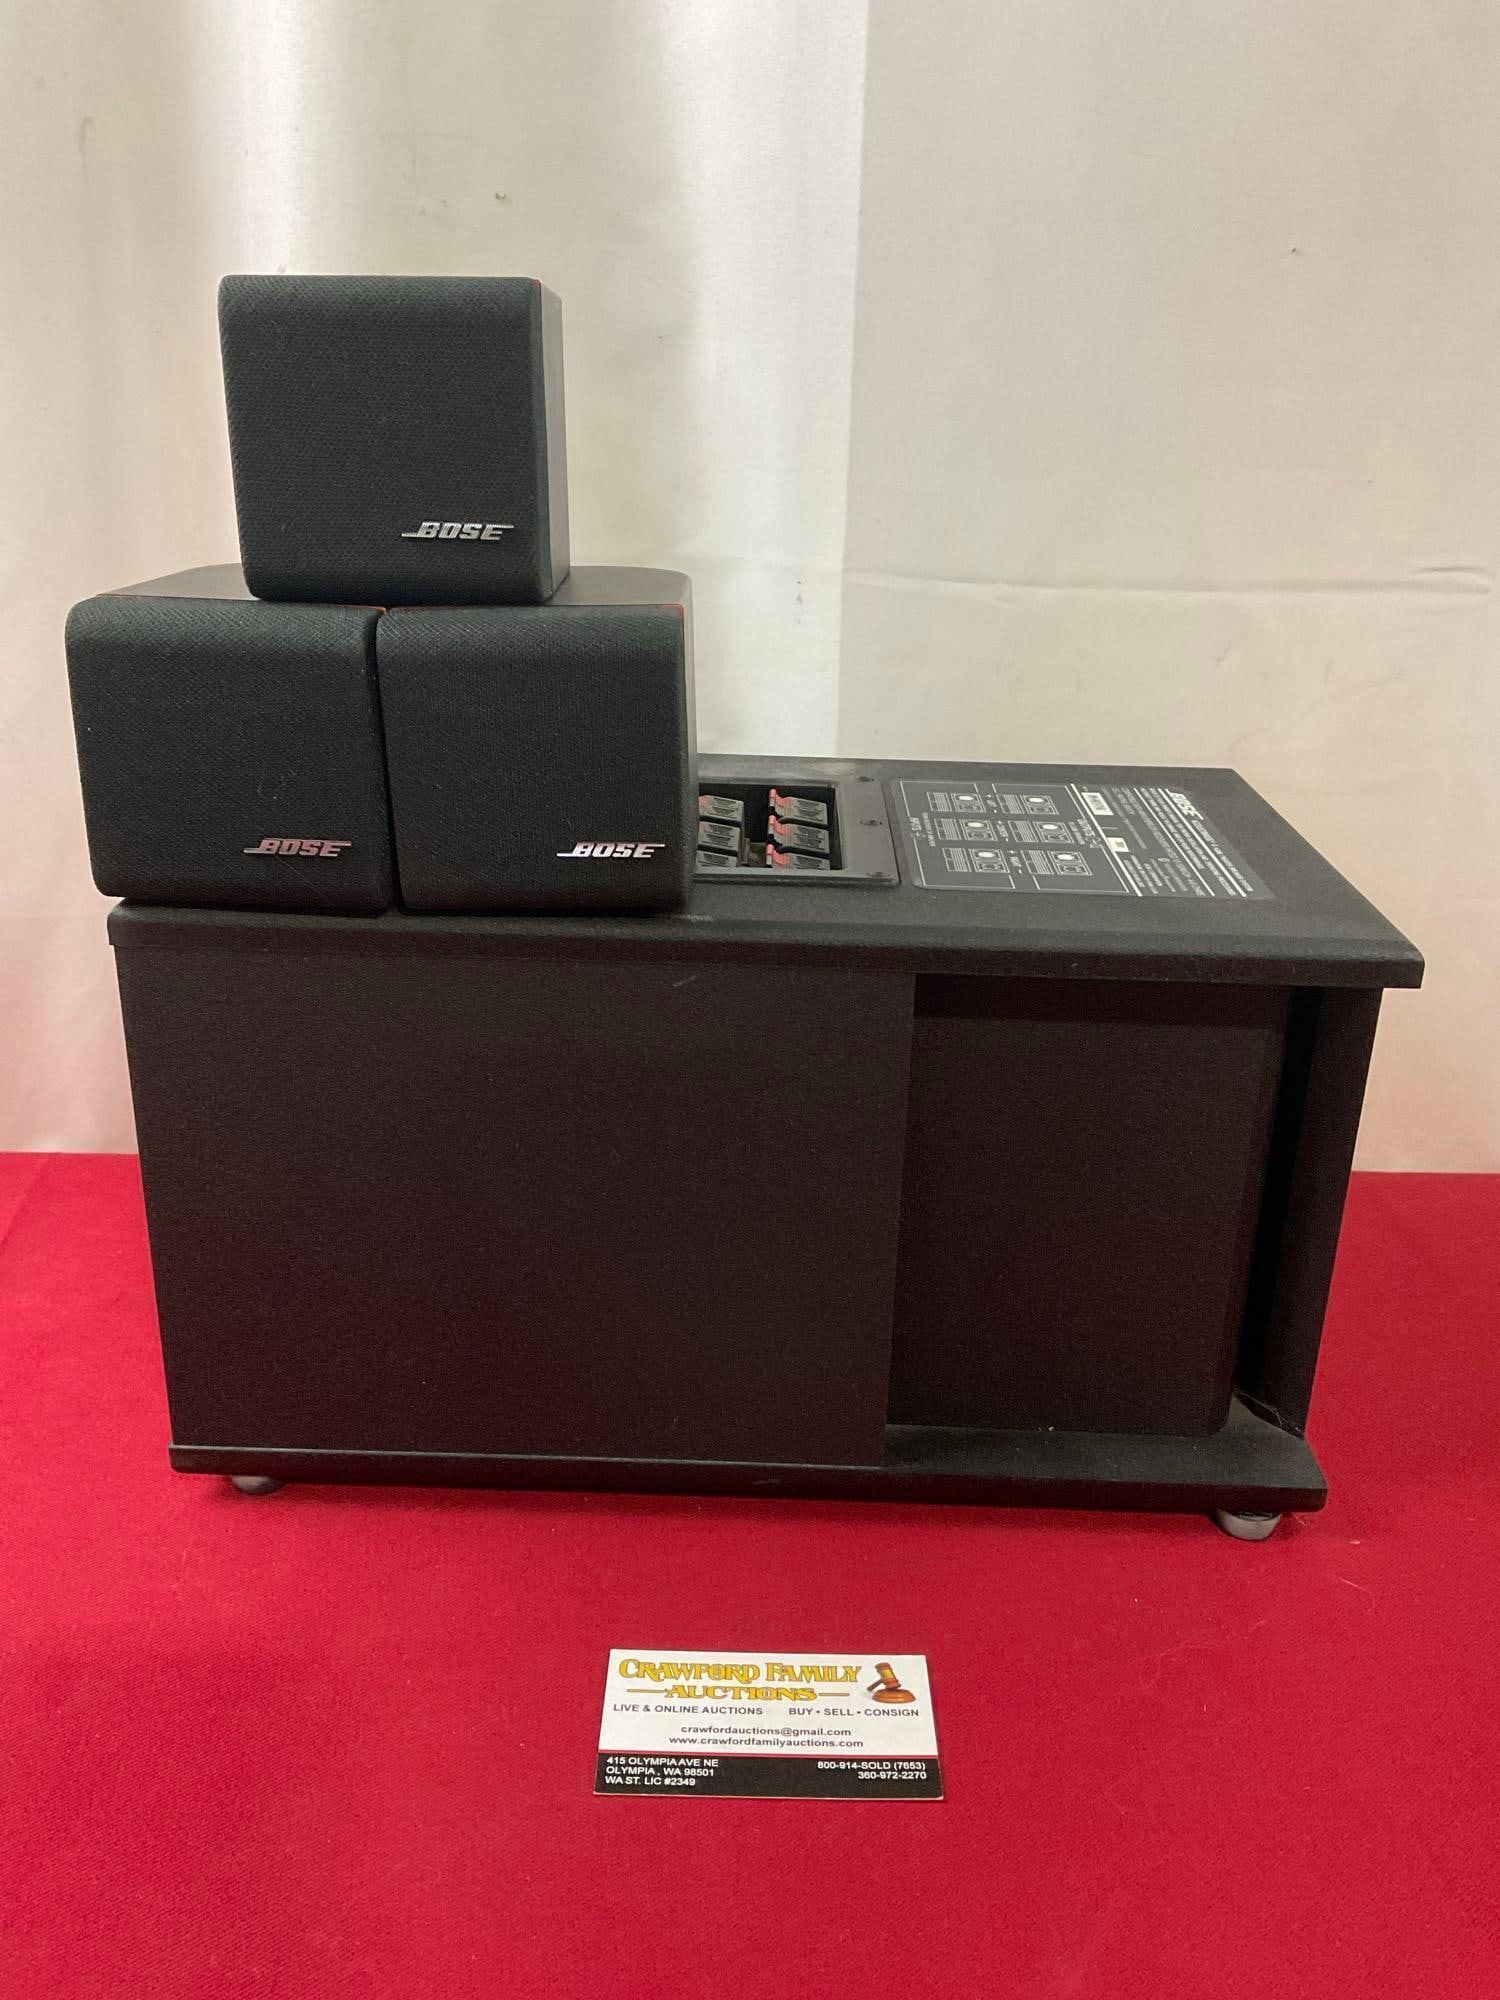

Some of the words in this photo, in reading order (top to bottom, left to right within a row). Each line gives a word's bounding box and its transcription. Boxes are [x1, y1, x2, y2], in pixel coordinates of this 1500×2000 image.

[401, 521, 514, 541] BOSE
[243, 838, 352, 857] BOSE
[557, 842, 666, 858] BOSE
[618, 1658, 761, 1684] CRAWFORD
[765, 1662, 862, 1683] FAMILY
[664, 1684, 818, 1702] AUCTIONS
[613, 1703, 639, 1712] LIVE
[643, 1704, 651, 1712] &
[654, 1704, 699, 1714] ONLINE
[702, 1706, 763, 1715] AUCTIONS
[788, 1707, 813, 1716] BUY
[824, 1708, 854, 1716] SELL
[864, 1708, 919, 1717] CONSIGN
[681, 1725, 852, 1737] crawfordauctions@gmail.com
[669, 1736, 864, 1748] www.crawfordfamilyauctions.com
[606, 1756, 626, 1765] 415
[628, 1757, 677, 1766] OLYMPIA
[678, 1758, 700, 1767] AVE
[703, 1759, 719, 1767] NE
[817, 1761, 891, 1770] 800-914-SOLD
[893, 1762, 926, 1771] (7653)
[663, 1767, 681, 1775] WA
[683, 1768, 714, 1777] 98501
[857, 1771, 927, 1780] 360-972-2270
[605, 1775, 623, 1784] WA
[625, 1776, 641, 1785] ST.
[644, 1777, 662, 1785] LIC
[664, 1777, 696, 1786] #2349
